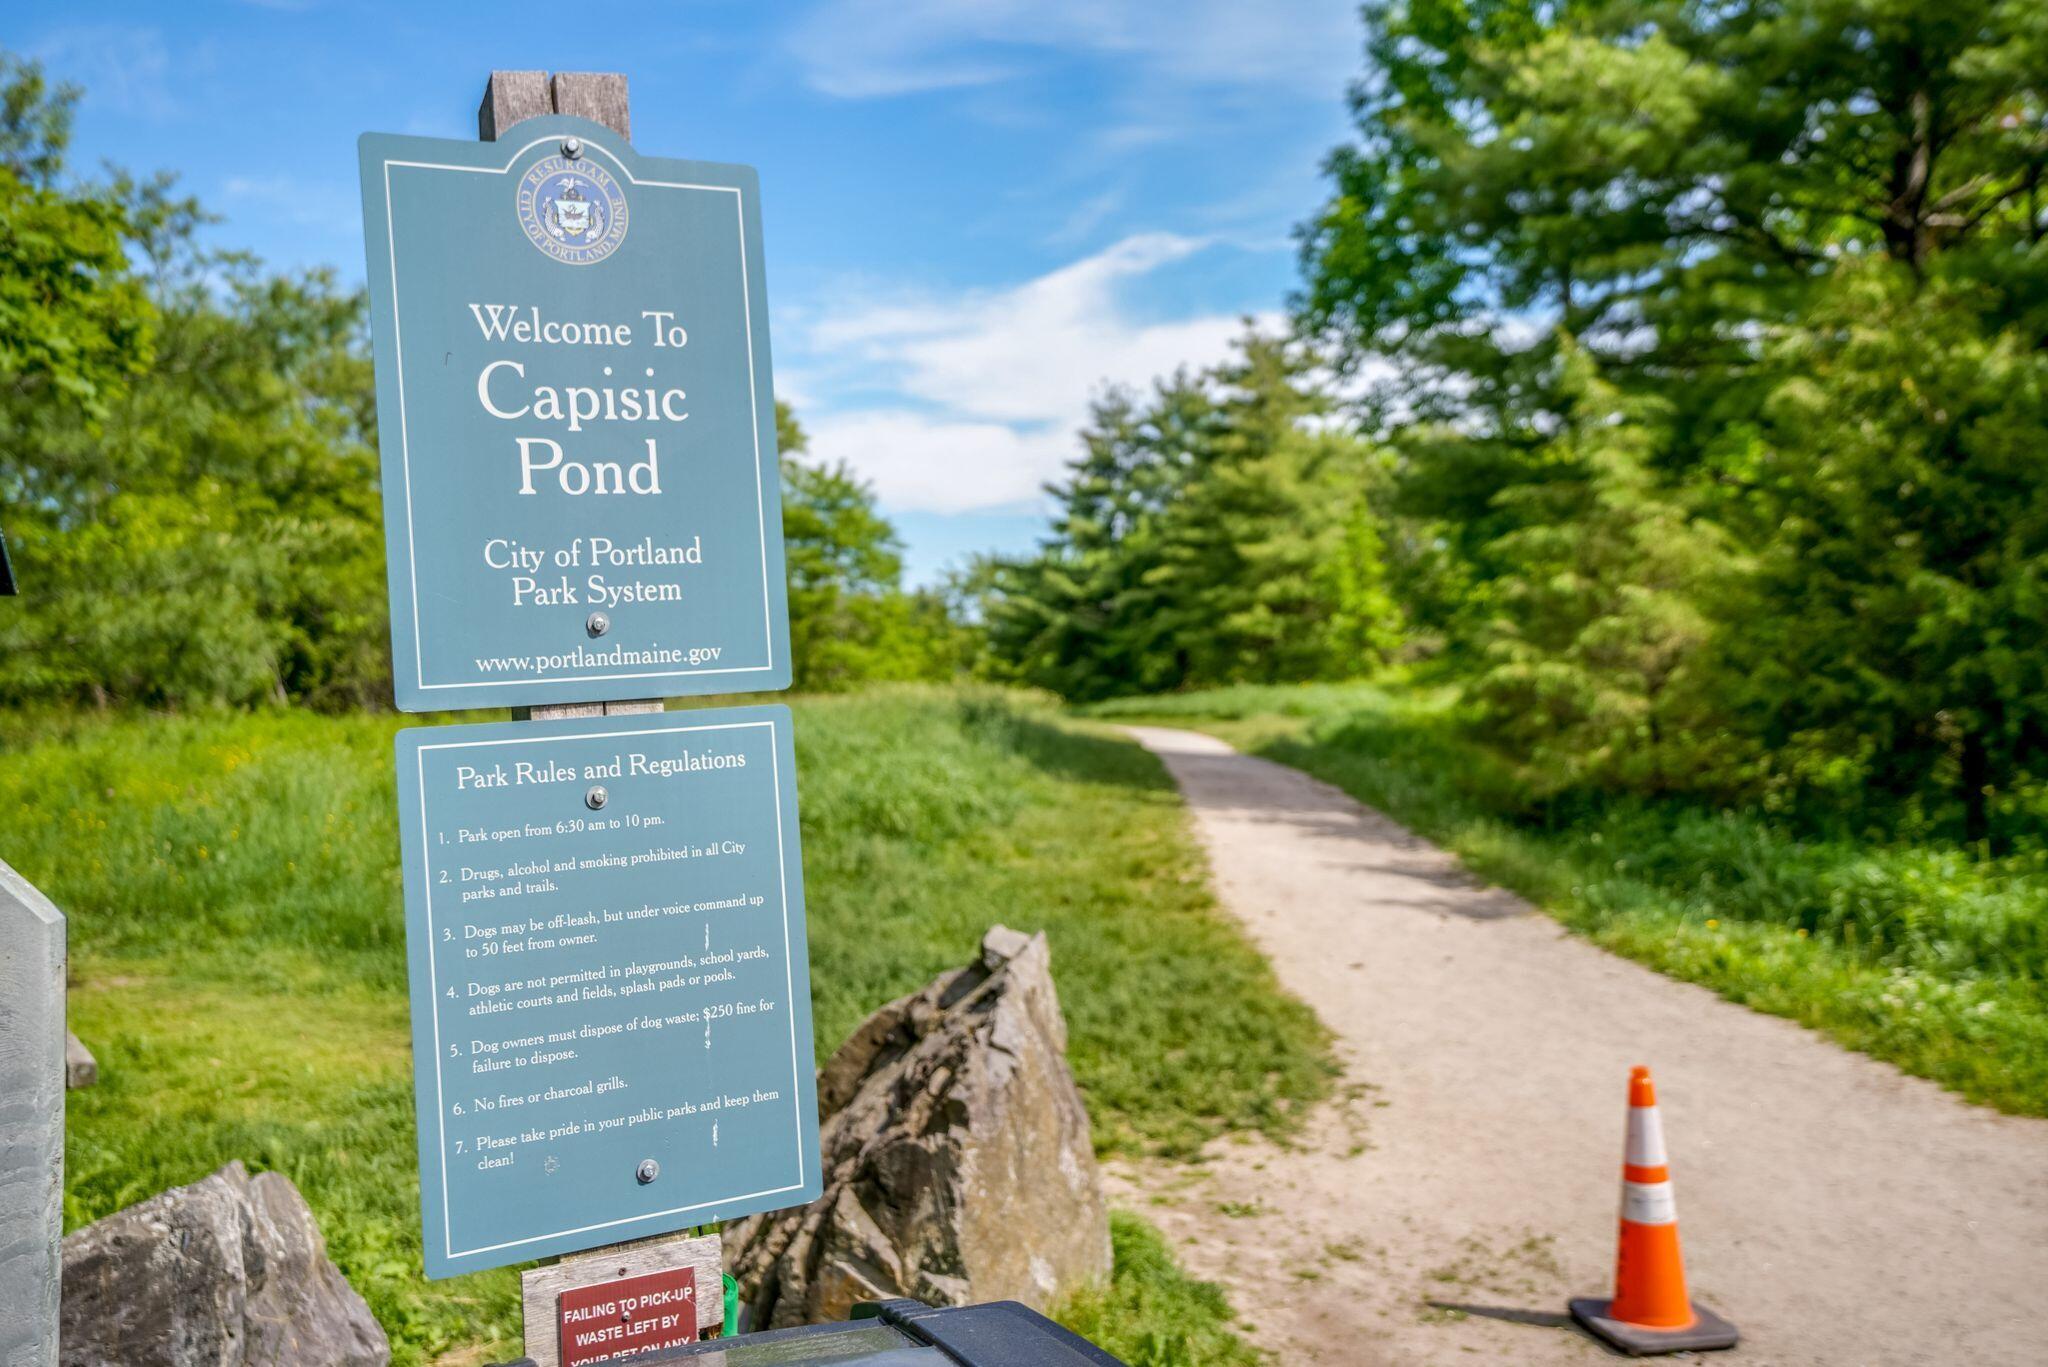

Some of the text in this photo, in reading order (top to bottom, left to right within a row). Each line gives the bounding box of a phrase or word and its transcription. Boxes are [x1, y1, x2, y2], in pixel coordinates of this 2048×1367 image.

[520, 190, 533, 221] CITY
[528, 225, 543, 242] OF
[610, 199, 625, 241] MAINE
[468, 303, 687, 347] Welcome To
[477, 360, 688, 431] Capisic
[515, 437, 662, 495] Pond
[484, 535, 702, 573] City of Portland
[512, 574, 682, 608] Park System
[475, 643, 722, 674] www.portlandmaine.gov
[456, 749, 746, 789] Park Rules and Regulations
[439, 814, 664, 845] 1. Park open from 6:30 am to 10 pm.
[439, 840, 745, 883] 2. Drugs, alcohol and smoking prohibited in all City
[462, 878, 558, 902] parks and trails.
[443, 893, 764, 941] 3. Dogs may be off-leash, but under voice command up
[465, 934, 597, 958] to 50 feet from owner.
[446, 945, 769, 998] 4. Dogs are not permitted in playgrounds, school yards,
[468, 967, 735, 1015] athletic courts and fields, splash pads or pools.
[450, 998, 774, 1057] 5. Dog owners must dispose of dog waste; $250 fine for
[472, 1050, 578, 1073] failure to dispose.
[453, 1075, 628, 1115] 6. No fires or charcoal grills.
[455, 1089, 779, 1154] 7. Please take pride in your public parks and keep them
[477, 1154, 514, 1170] clean!
[564, 1286, 693, 1324] FAILING TO PICK-UP
[576, 1313, 680, 1346] WASTE LEFT BY
